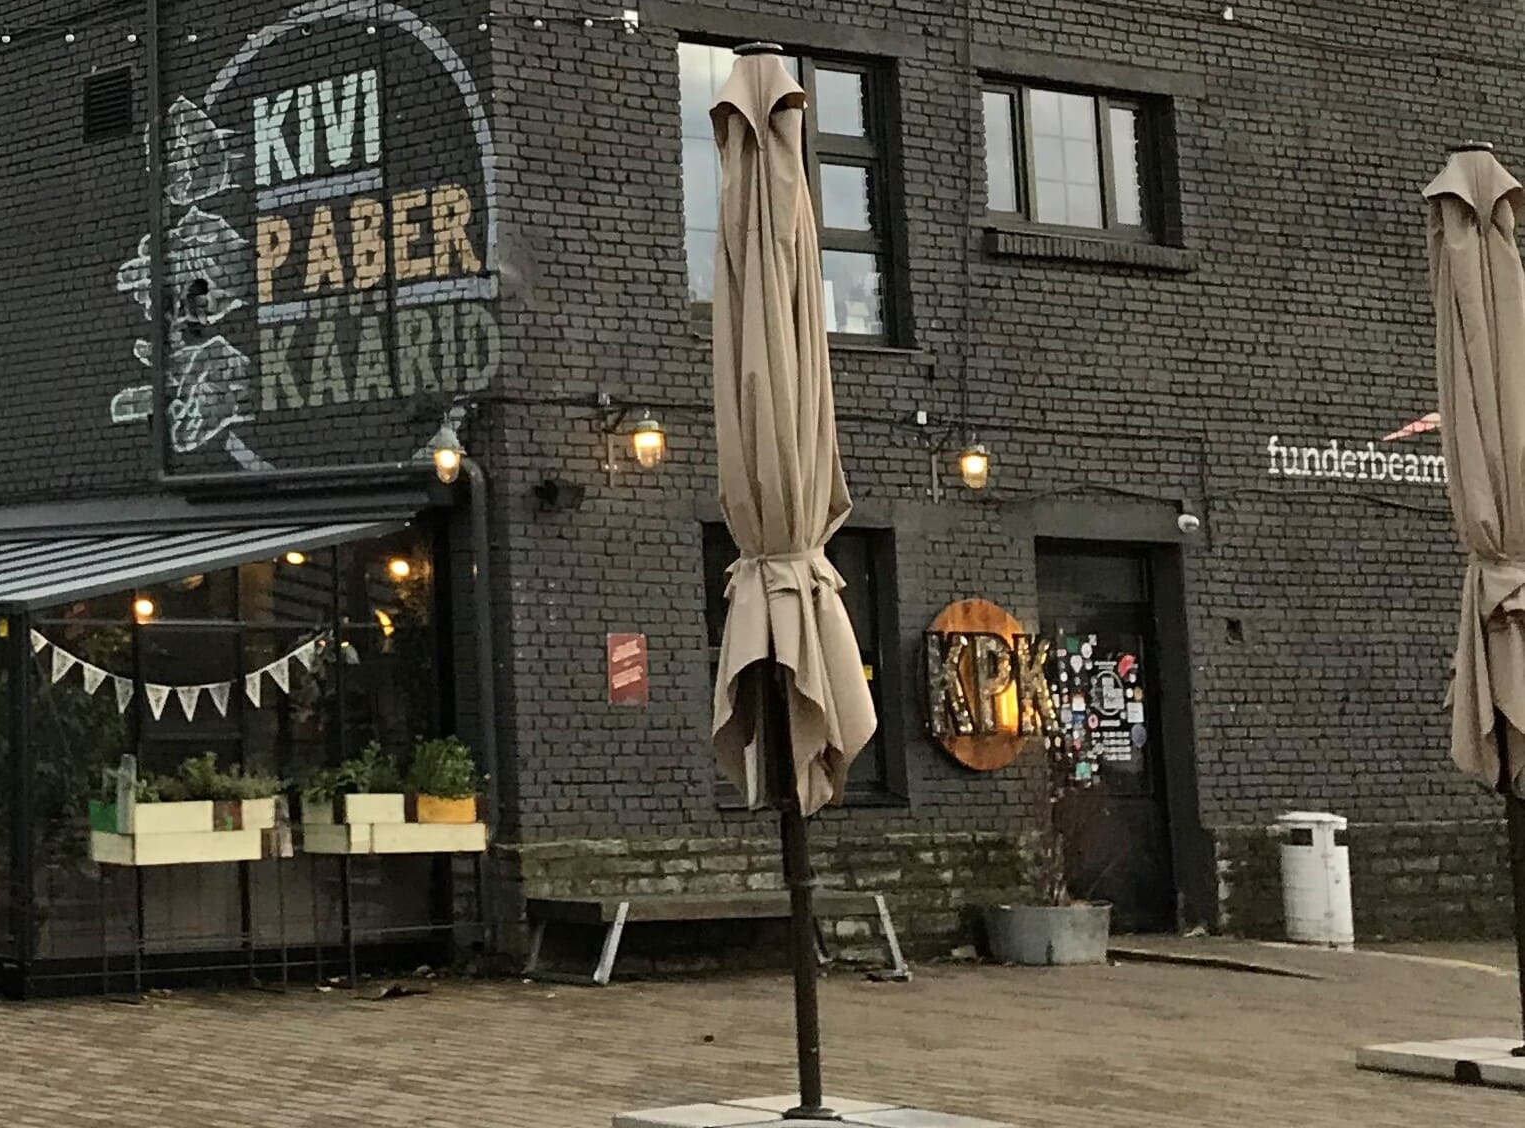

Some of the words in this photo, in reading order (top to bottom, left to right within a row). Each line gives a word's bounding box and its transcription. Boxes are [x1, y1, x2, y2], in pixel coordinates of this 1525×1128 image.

[253, 70, 381, 187] KIVI
[255, 183, 481, 305] PABER
[259, 302, 501, 412] KAARID
[1267, 435, 1449, 483] funderbeam
